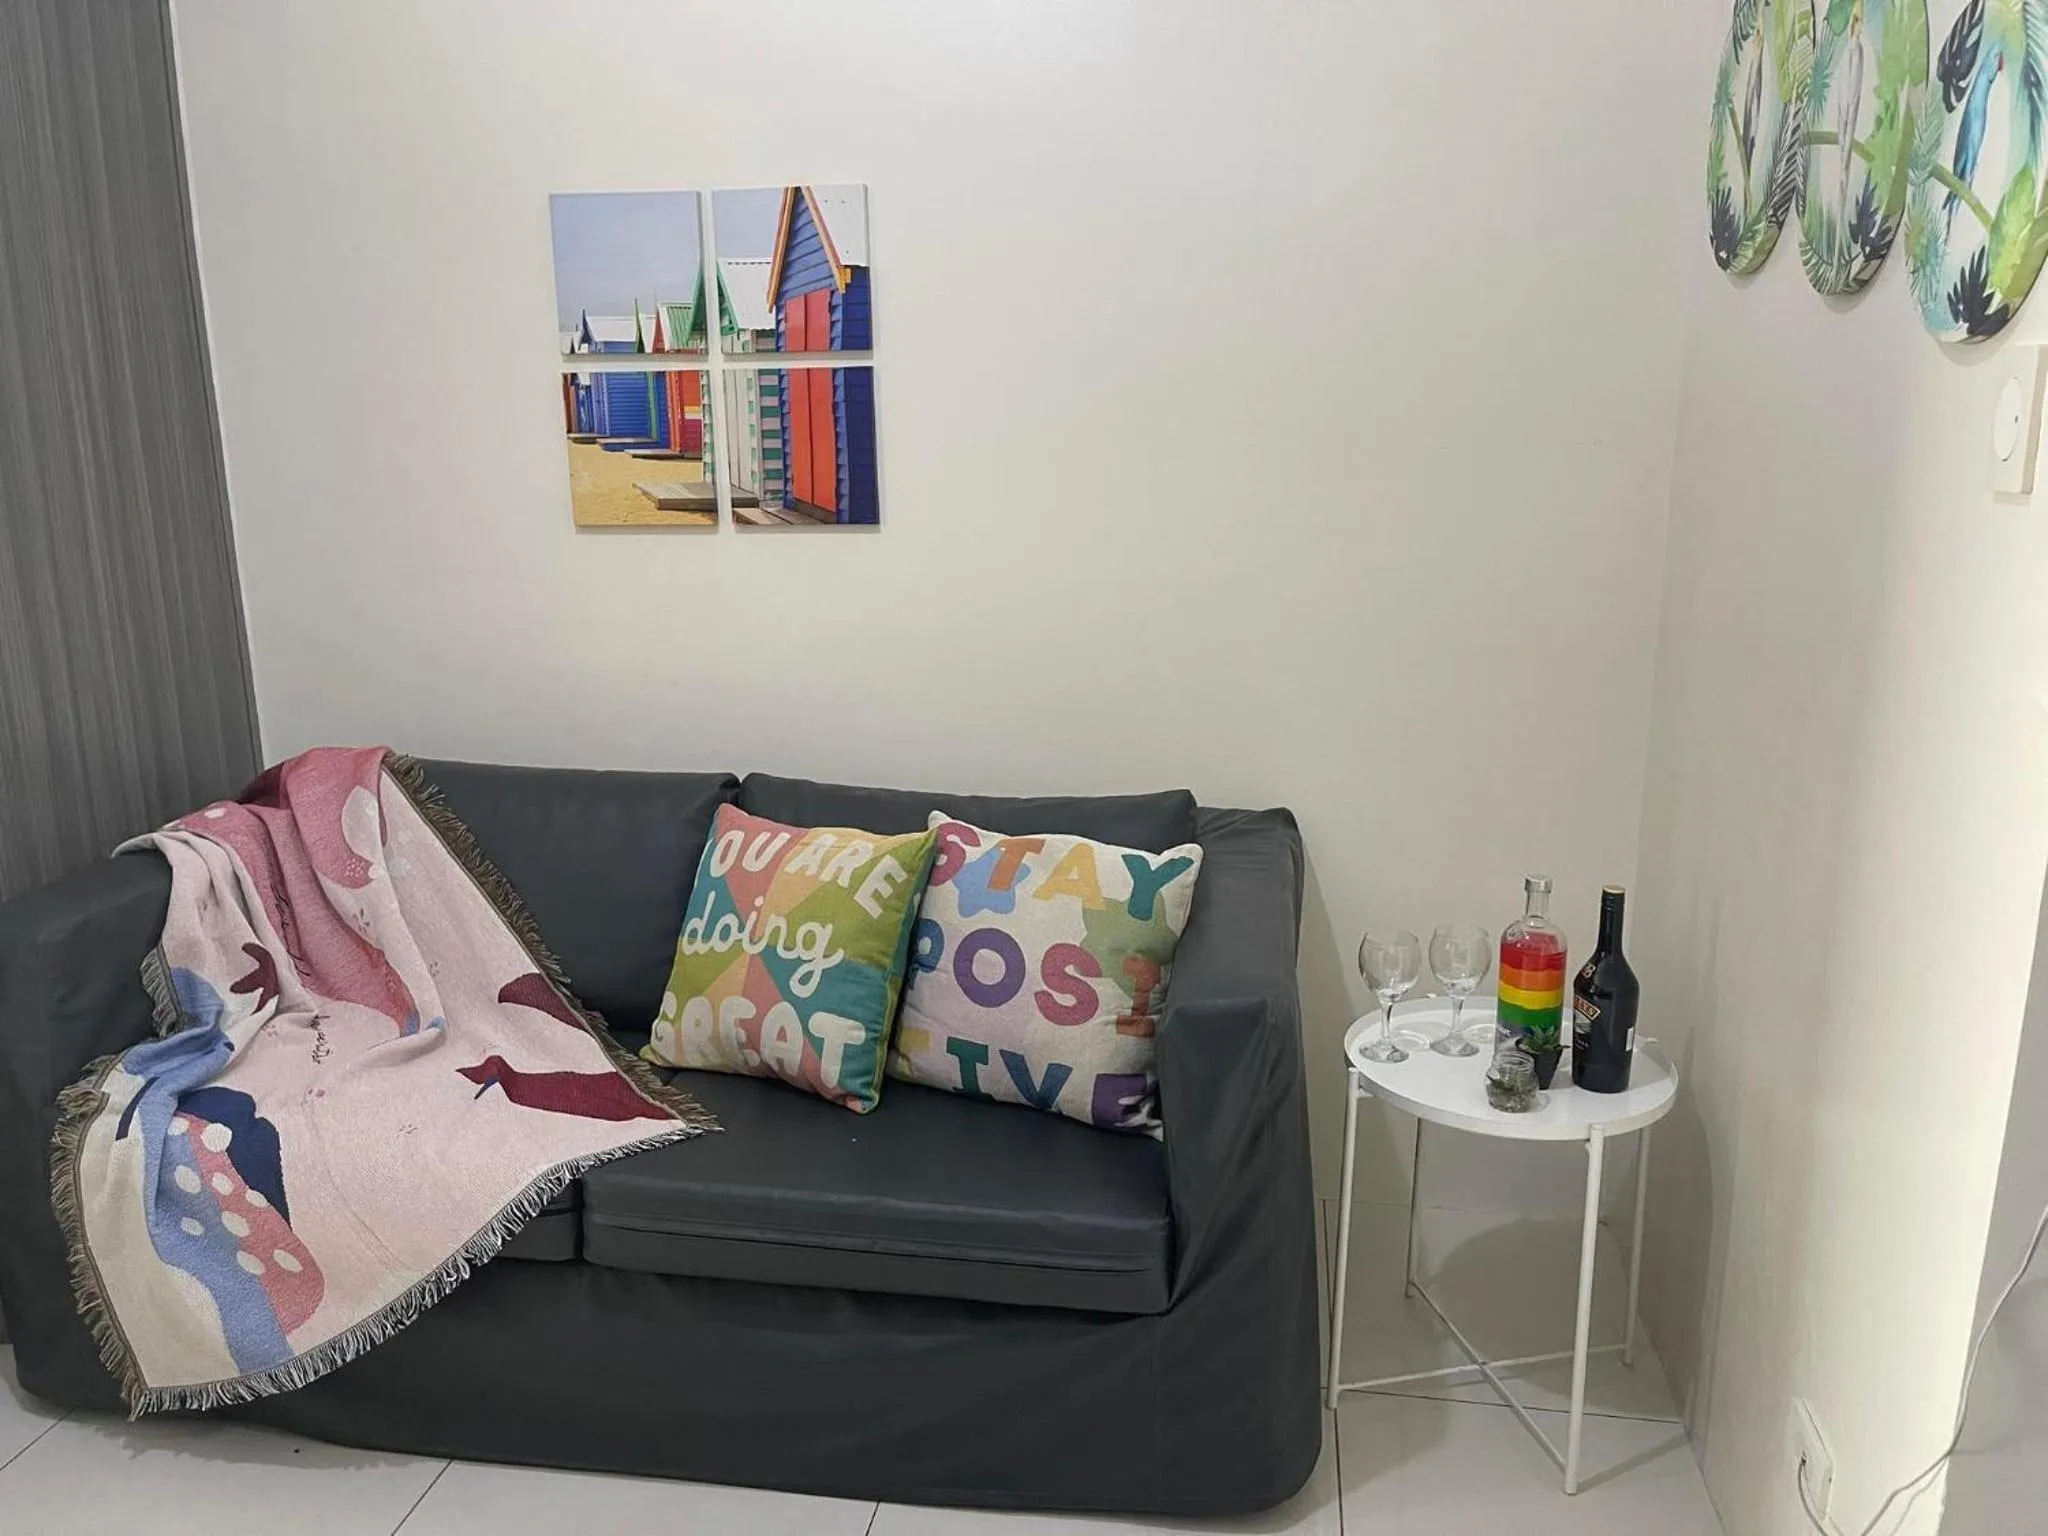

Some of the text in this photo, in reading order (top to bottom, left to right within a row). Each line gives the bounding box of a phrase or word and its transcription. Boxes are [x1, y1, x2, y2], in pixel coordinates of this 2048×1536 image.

[783, 834, 908, 920] ARE
[929, 822, 1195, 922] STAY
[682, 892, 845, 998] doing
[651, 991, 866, 1088] GREAT
